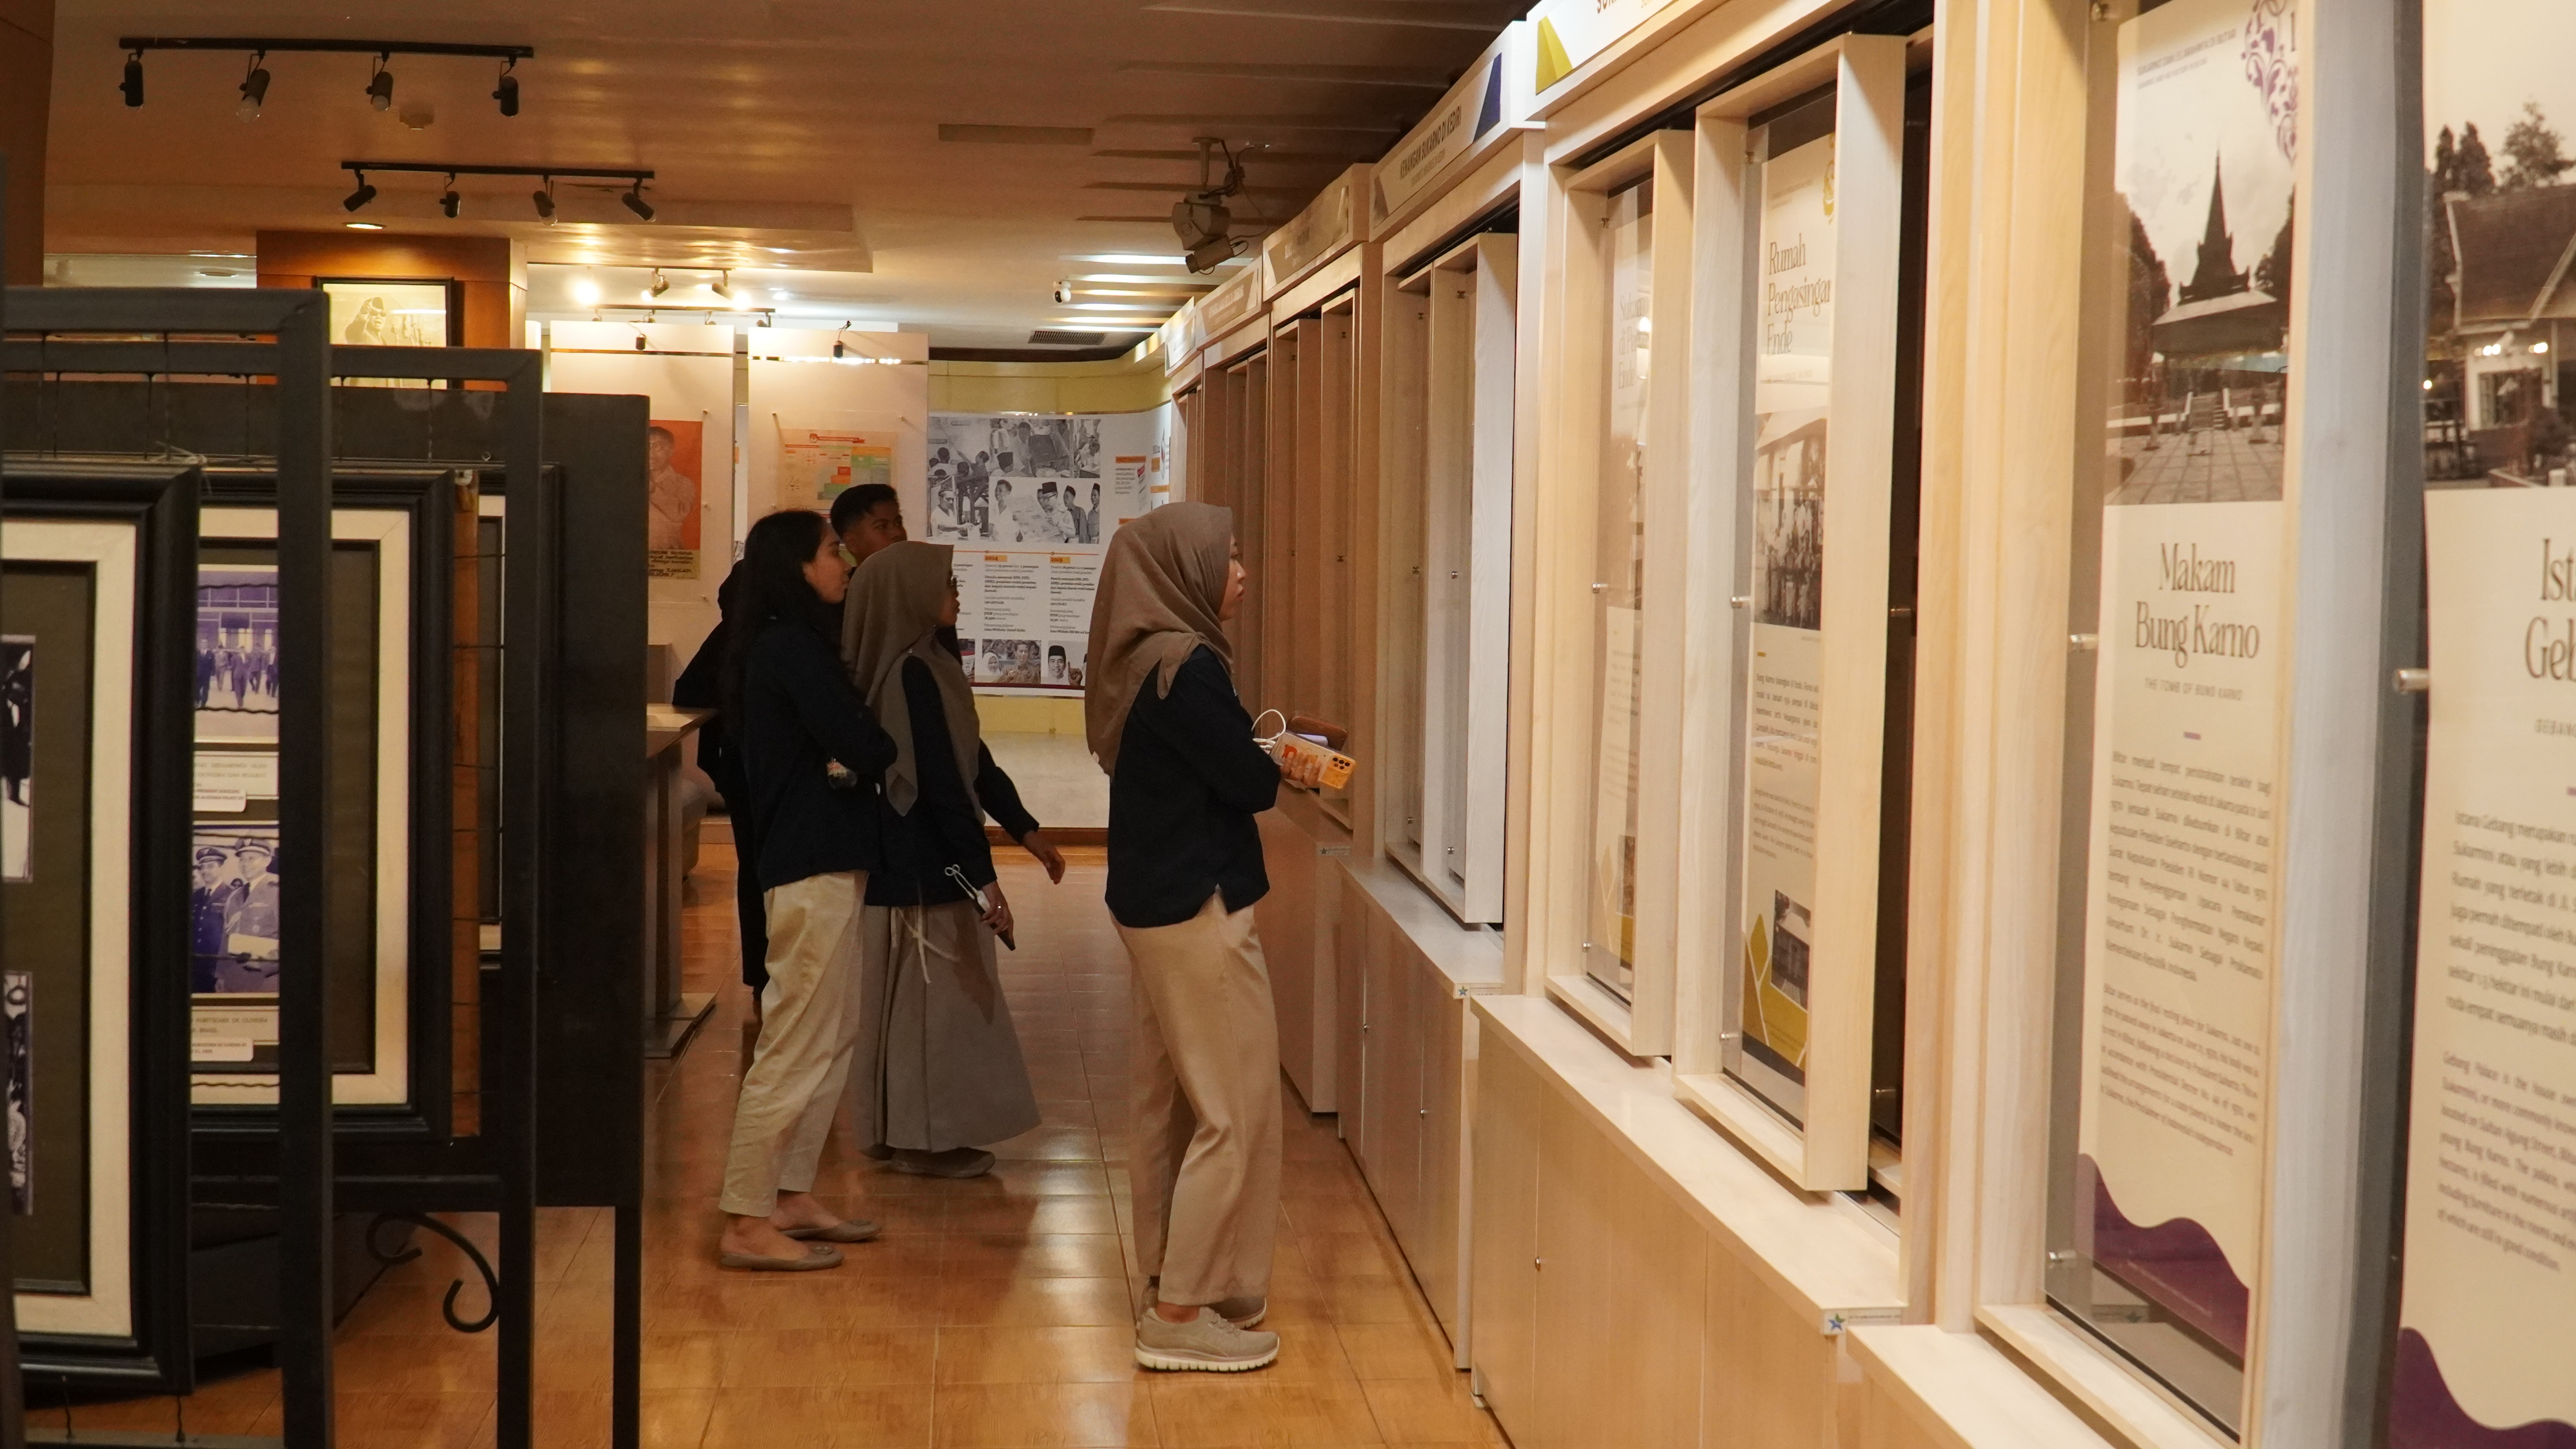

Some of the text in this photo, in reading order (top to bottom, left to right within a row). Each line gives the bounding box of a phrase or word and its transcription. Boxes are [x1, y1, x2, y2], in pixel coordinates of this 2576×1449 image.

[1769, 232, 1806, 275] Rumah
[1767, 320, 1792, 357] Ende
[2158, 543, 2236, 593] Makam
[2540, 538, 2576, 601] Ist
[2135, 601, 2260, 668] Bung Karno
